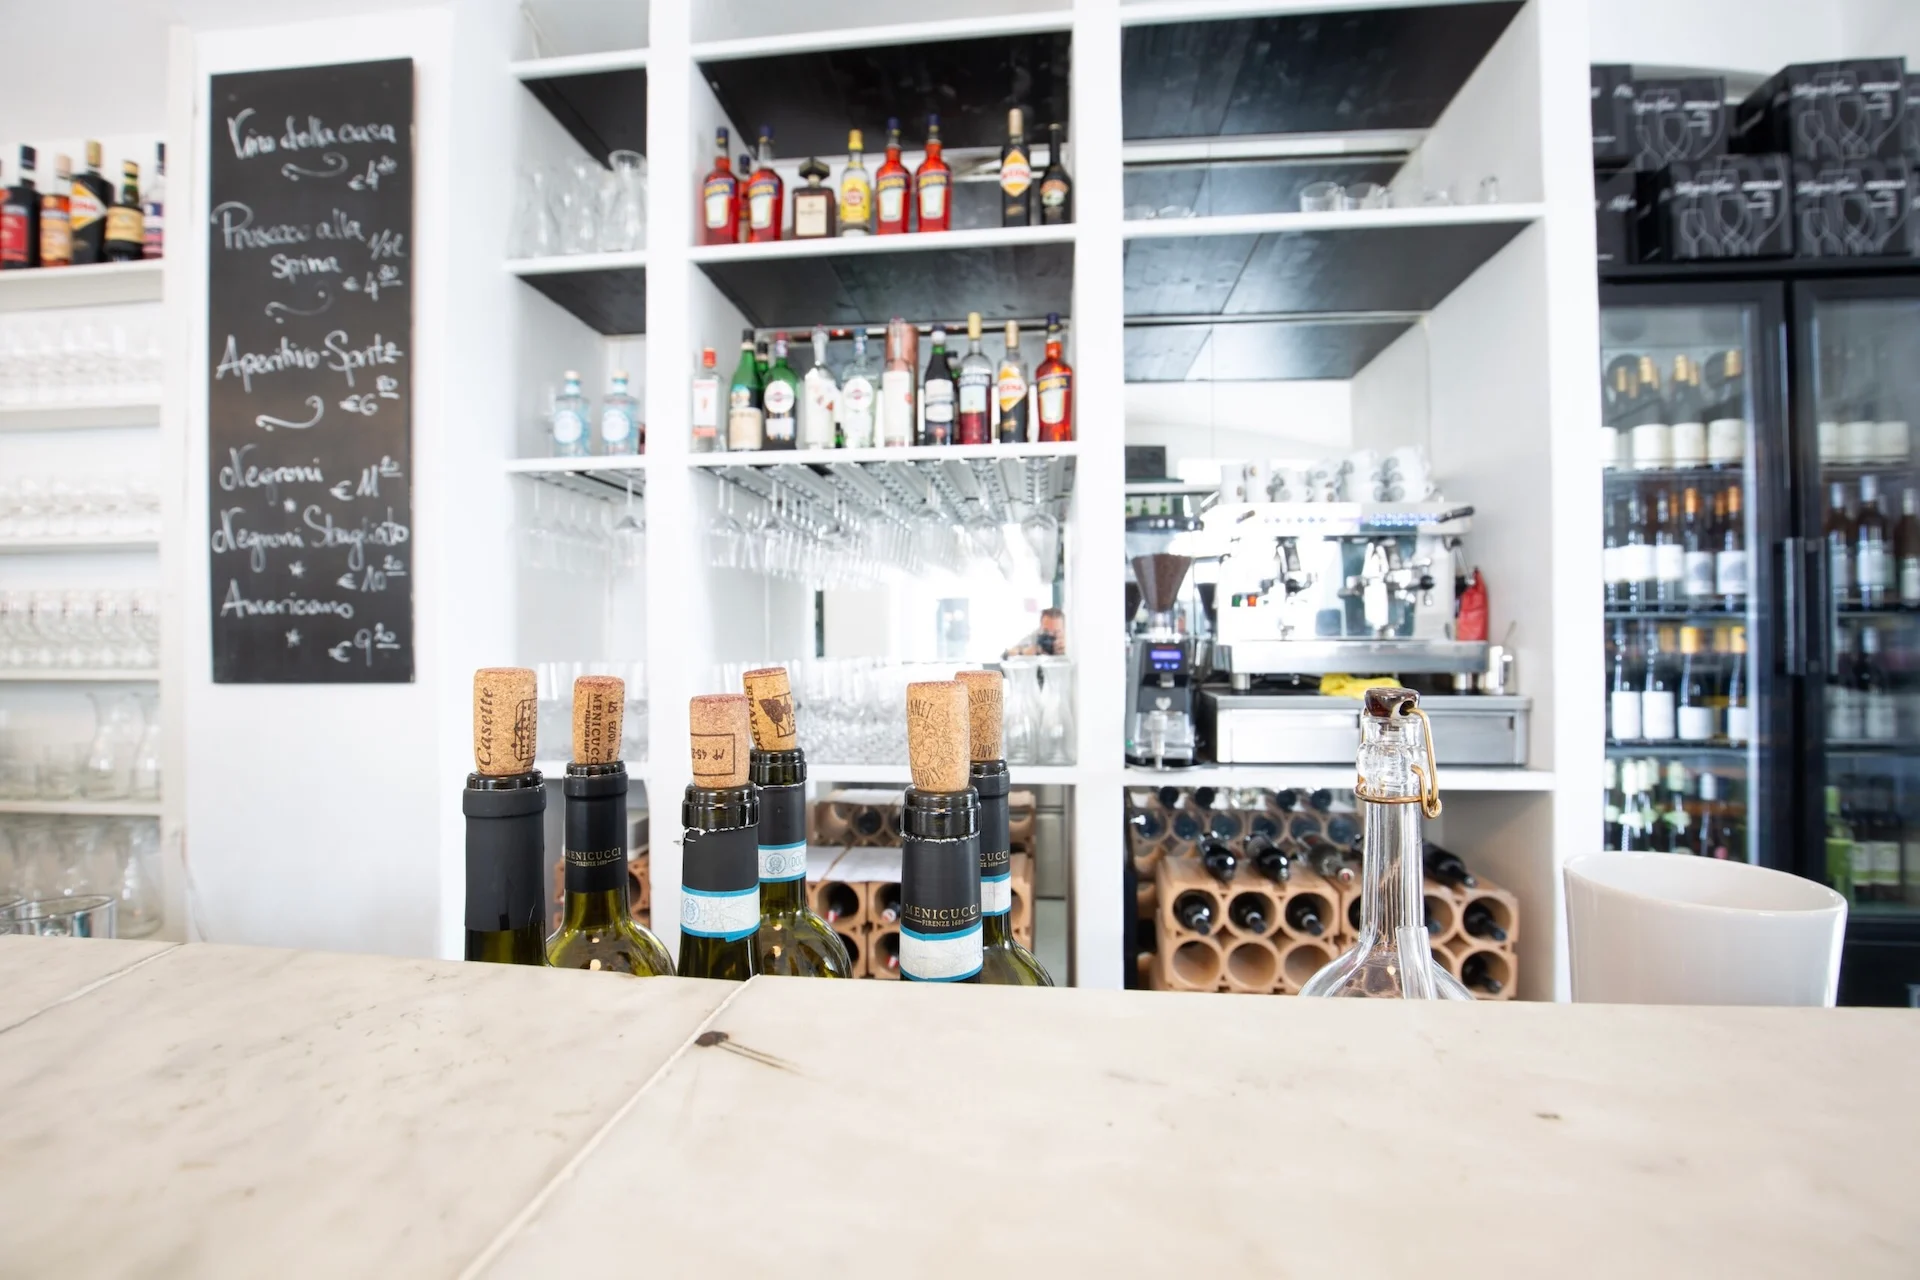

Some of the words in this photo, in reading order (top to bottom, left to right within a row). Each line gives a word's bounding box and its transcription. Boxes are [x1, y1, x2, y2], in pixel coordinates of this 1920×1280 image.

[227, 107, 277, 160] Vino
[280, 115, 337, 151] della
[337, 122, 397, 144] casa
[211, 201, 309, 251] Prosecco
[316, 207, 367, 242] alla
[218, 443, 324, 507] Negroni
[210, 506, 305, 574] Negroni
[219, 577, 354, 621] Americano
[477, 686, 494, 766] Casette
[905, 902, 979, 920] MENICUCCI
[921, 919, 950, 928] FIRENZE
